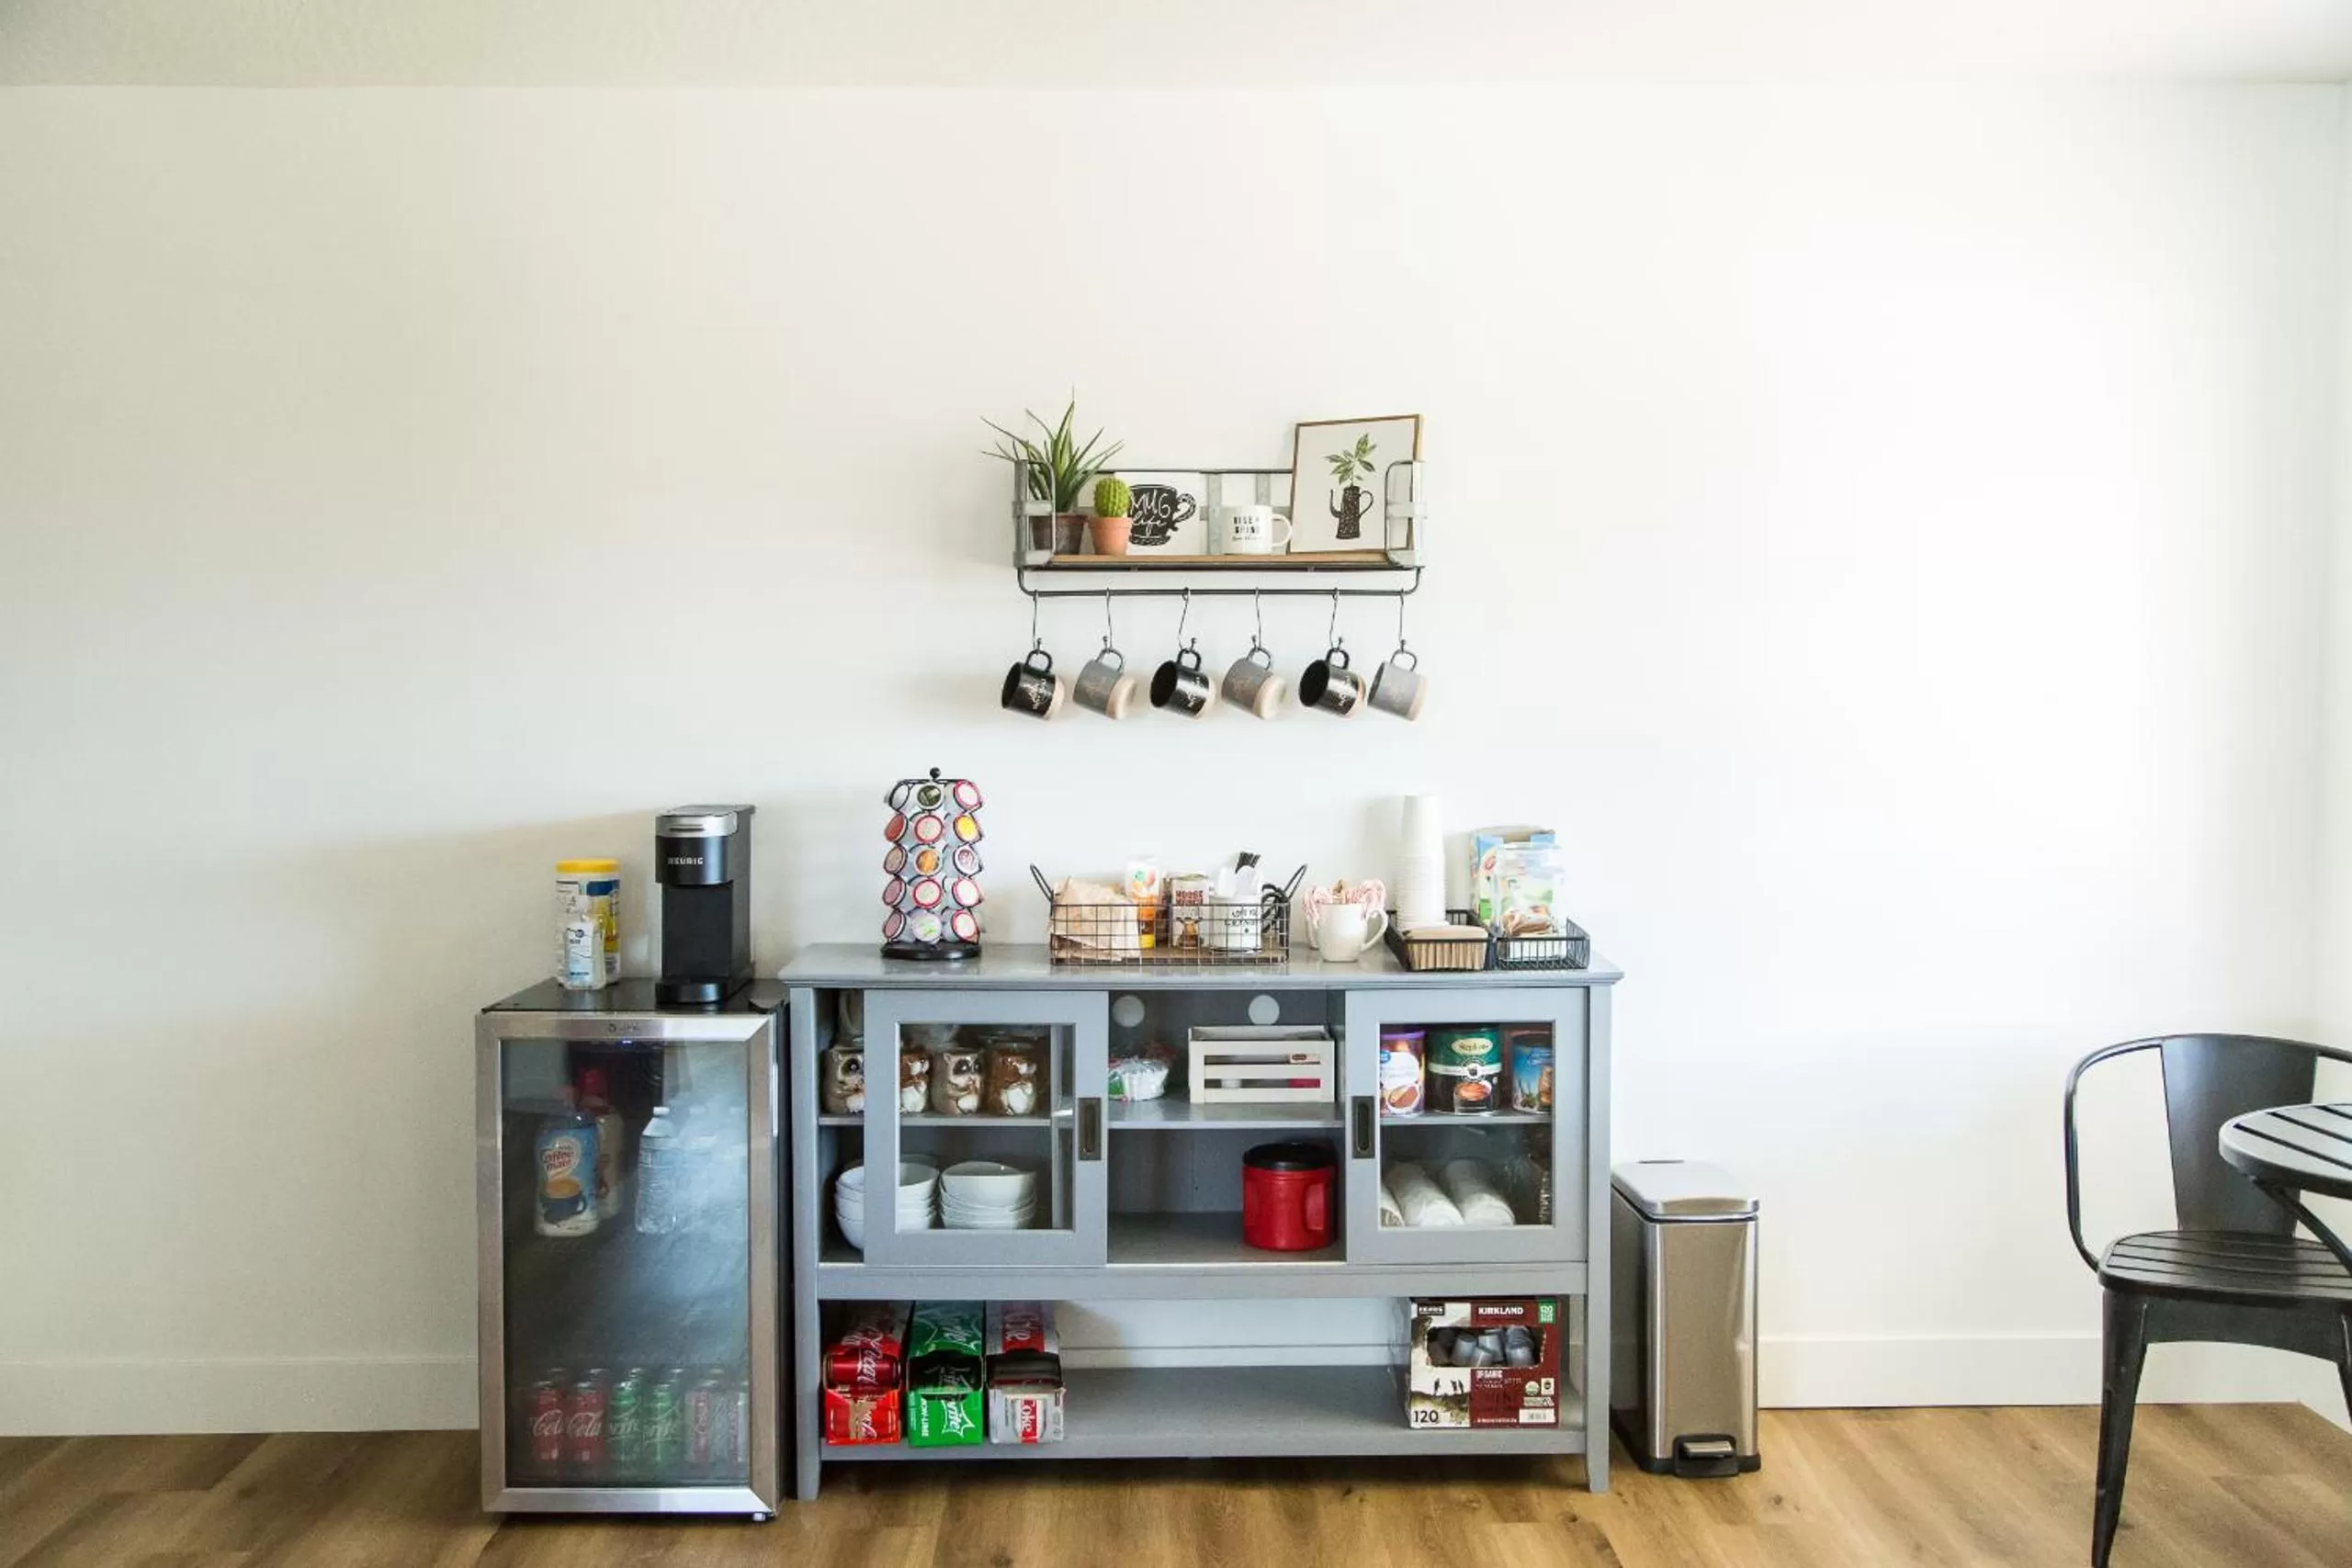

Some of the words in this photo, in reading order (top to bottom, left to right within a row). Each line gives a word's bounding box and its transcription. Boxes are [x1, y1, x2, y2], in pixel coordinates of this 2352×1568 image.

[1129, 490, 1171, 518] MUG
[1477, 1307, 1524, 1315] KIRKLAND
[1414, 1411, 1439, 1423] 120
